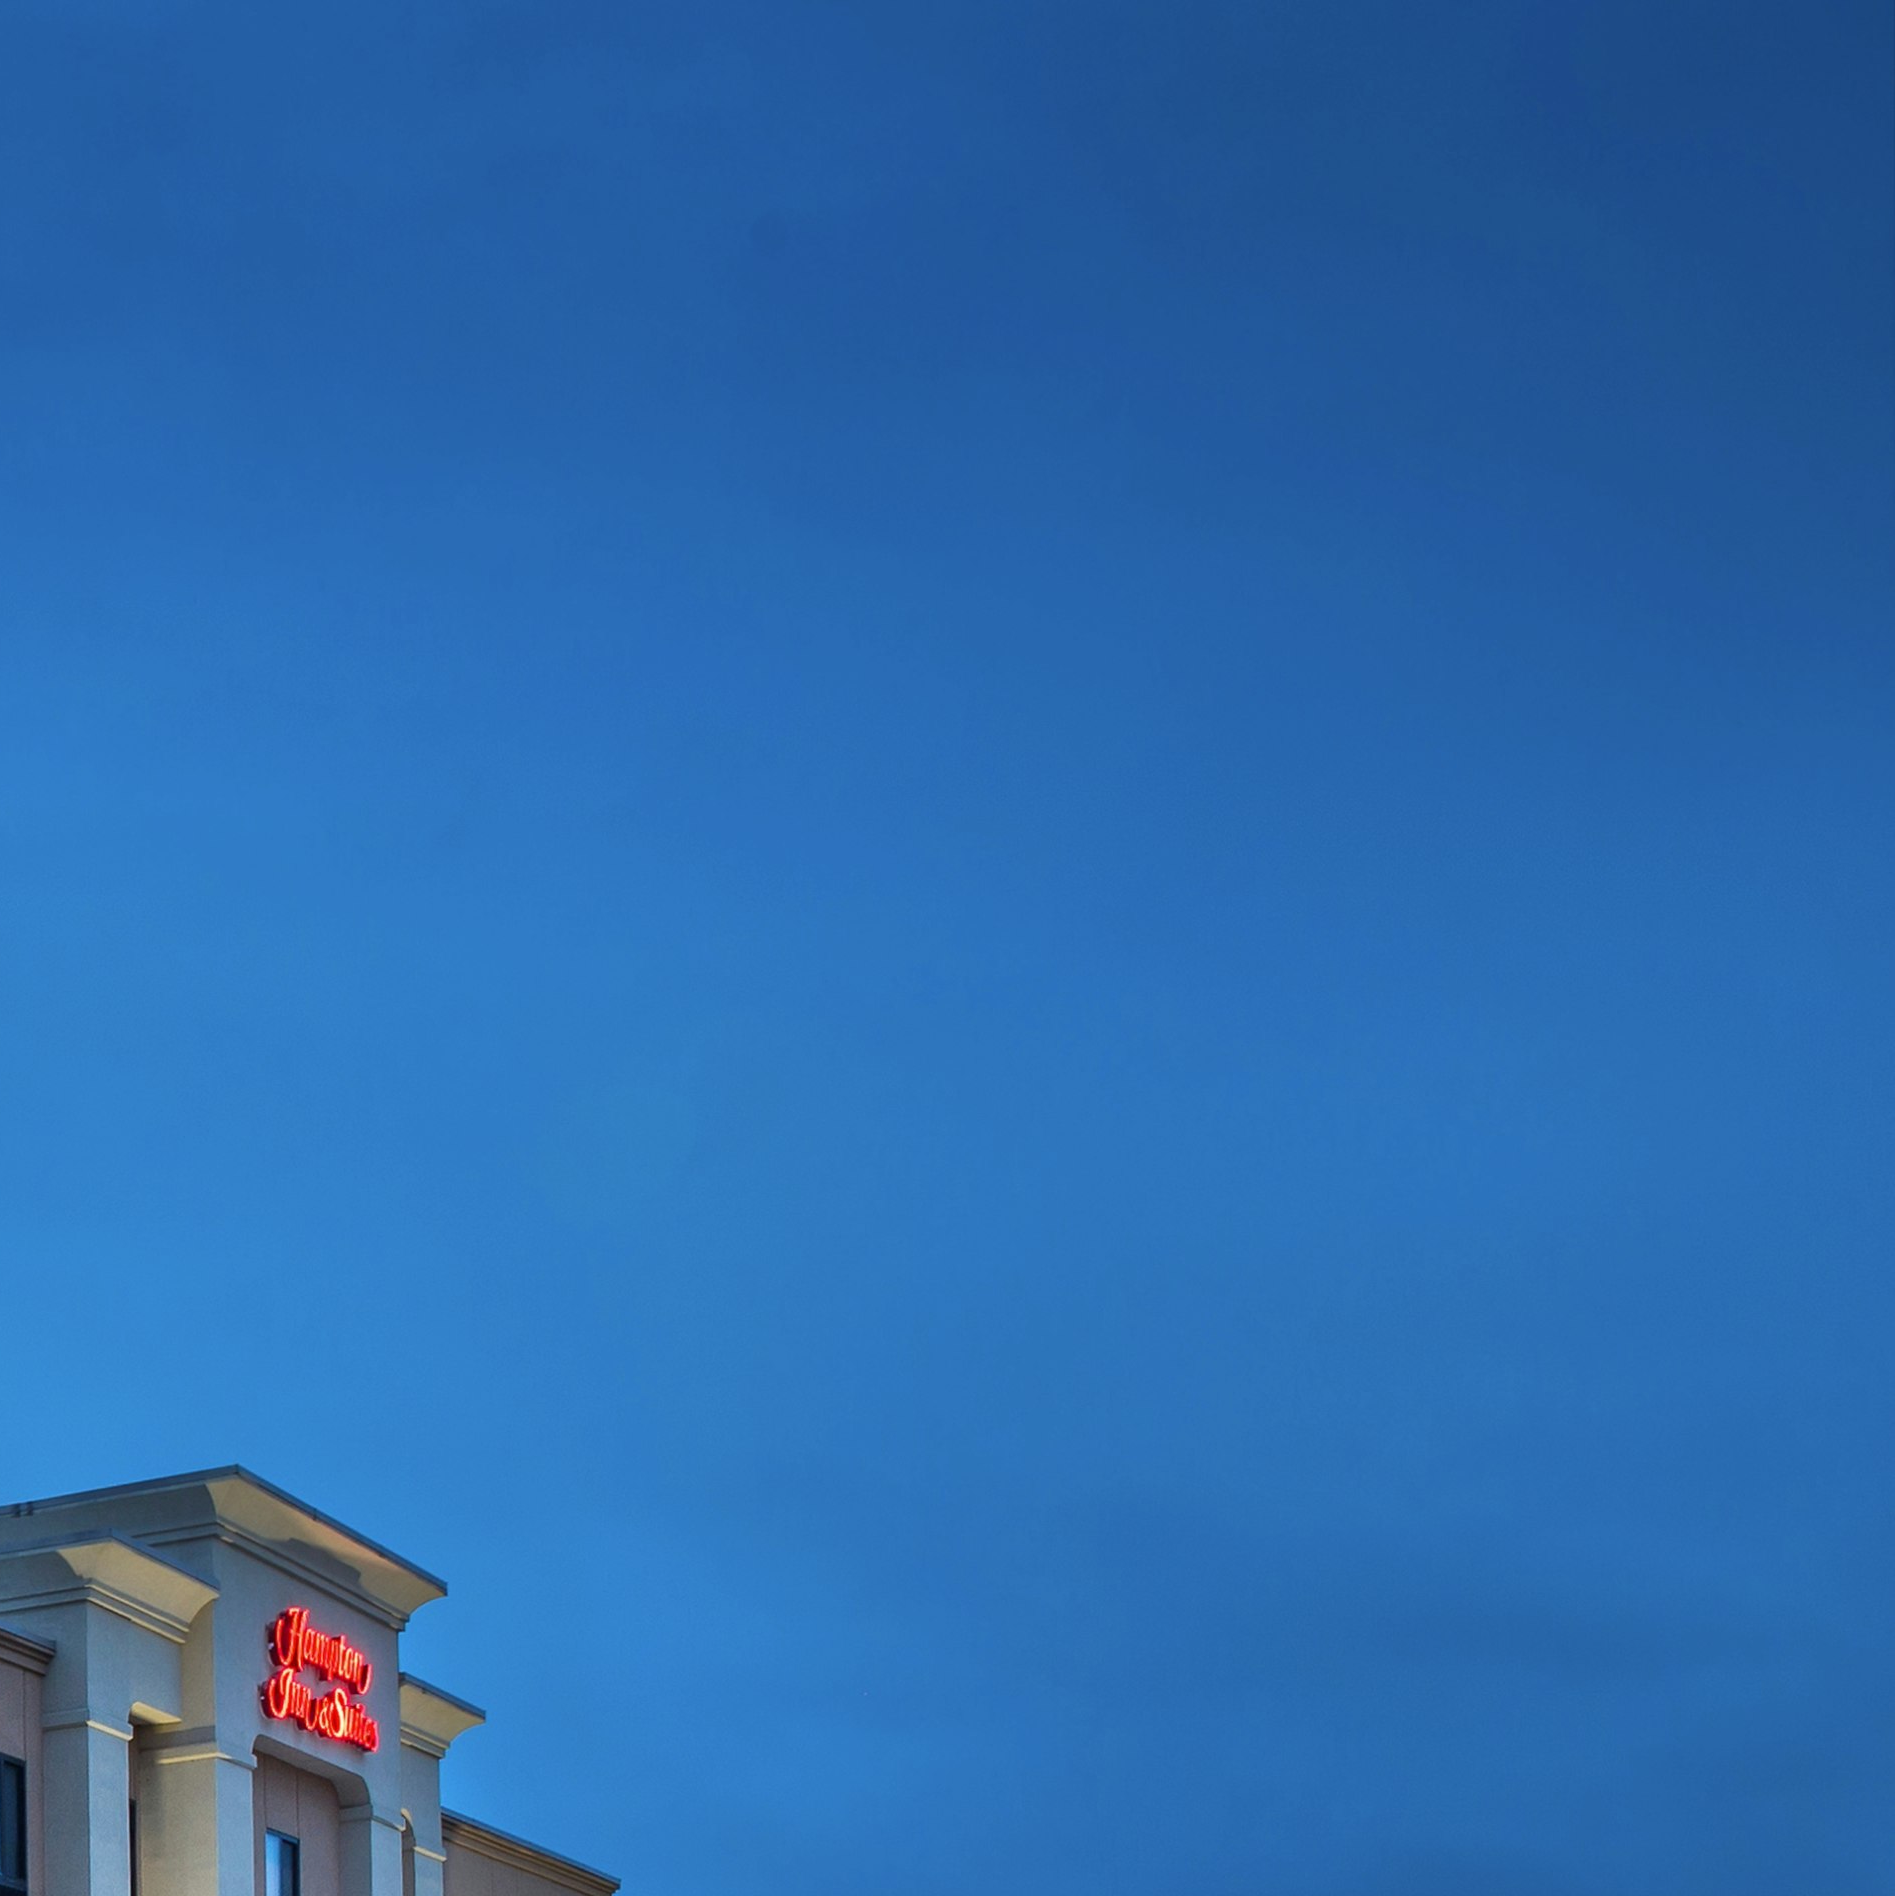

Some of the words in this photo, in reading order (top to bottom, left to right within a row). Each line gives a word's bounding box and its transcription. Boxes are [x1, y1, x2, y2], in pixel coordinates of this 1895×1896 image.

[270, 1606, 373, 1696] Hampton
[265, 1667, 321, 1731] Inn
[328, 1687, 380, 1753] Suites
